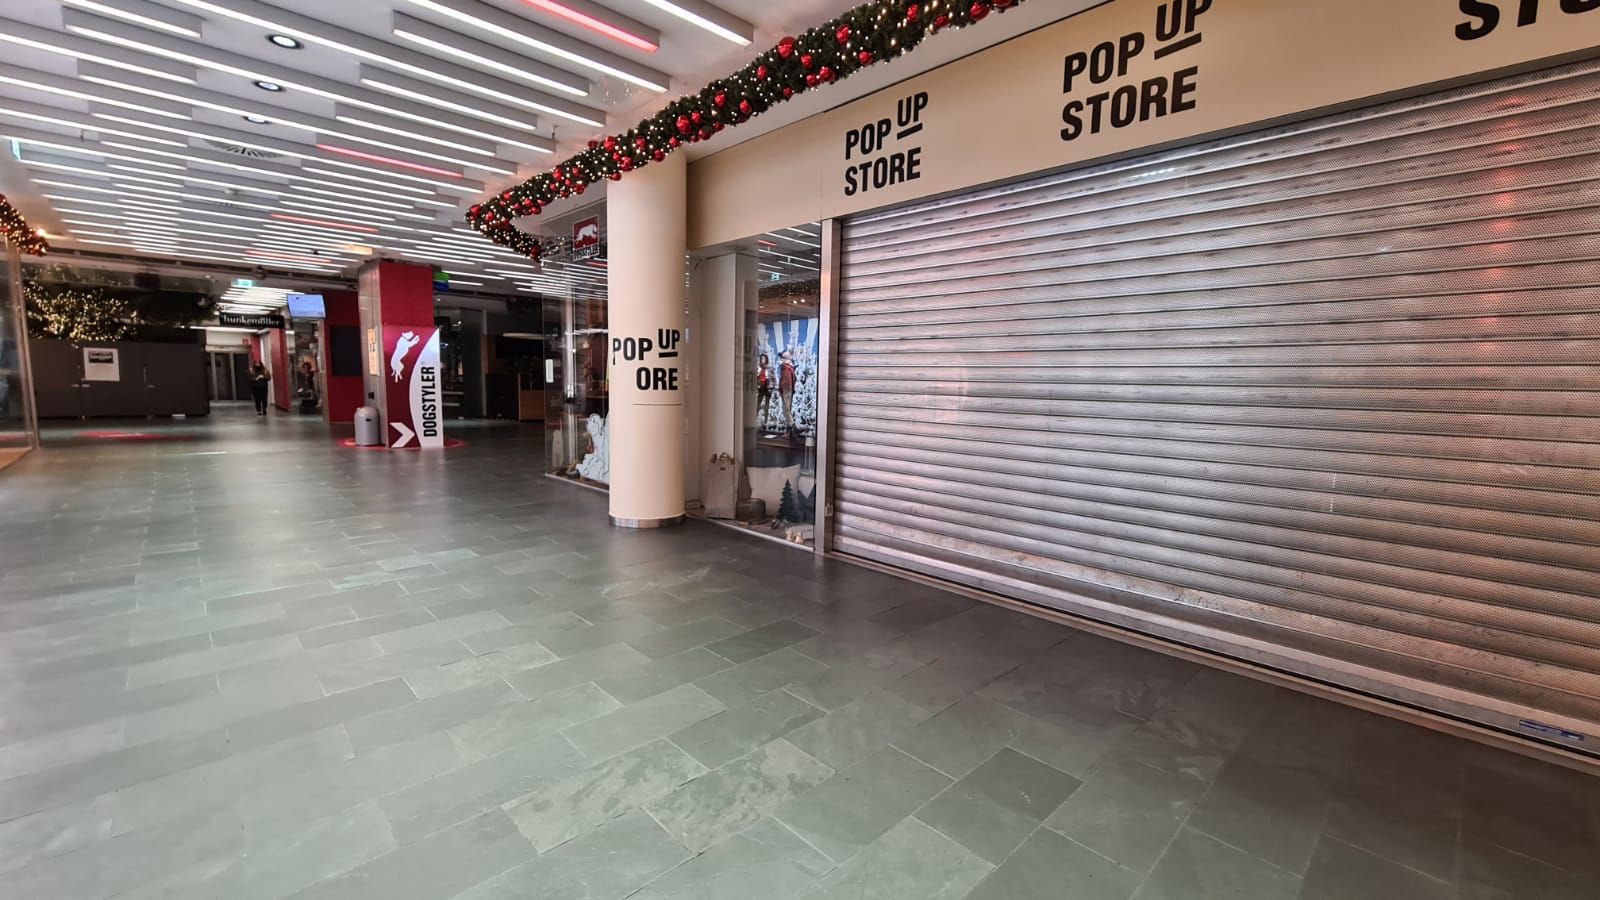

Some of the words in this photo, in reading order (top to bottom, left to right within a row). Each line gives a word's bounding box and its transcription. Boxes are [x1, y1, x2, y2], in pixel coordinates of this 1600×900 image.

[1063, 32, 1145, 94] POP
[1155, 0, 1212, 42] UP
[845, 118, 892, 160] POP
[897, 91, 928, 127] UP
[1060, 66, 1198, 141] STORE
[844, 146, 922, 196] STORE
[612, 337, 653, 365] POP
[658, 328, 680, 349] UP
[636, 367, 678, 390] ORE
[420, 366, 437, 437] DOGSTYLER
